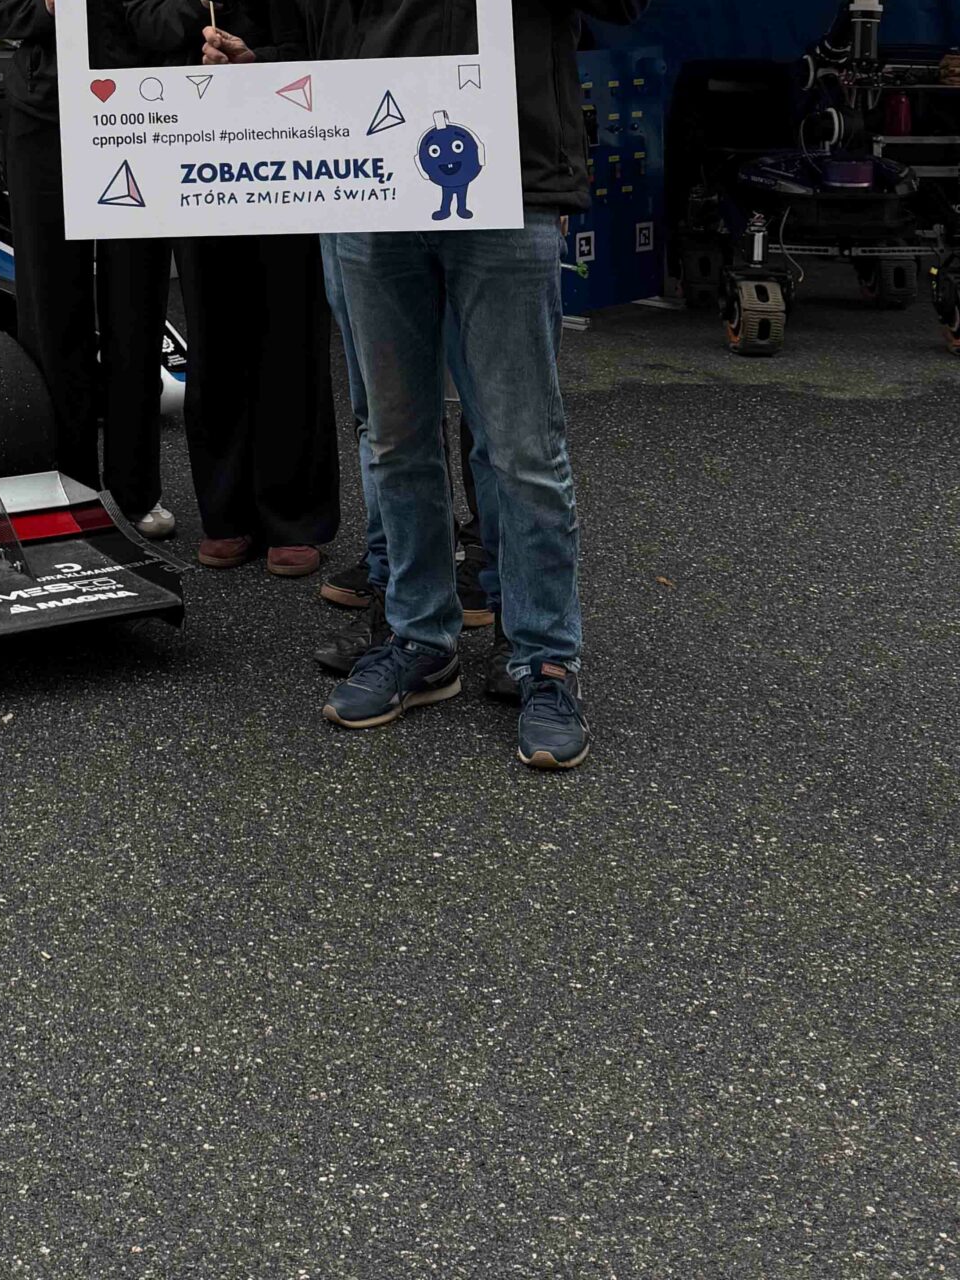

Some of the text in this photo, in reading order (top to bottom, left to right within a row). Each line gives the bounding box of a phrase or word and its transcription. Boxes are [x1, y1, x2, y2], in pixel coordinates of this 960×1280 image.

[92, 112, 179, 126] 100 000 likes
[92, 125, 350, 147] cpnpolsl #cpnpolsl #politechnikaśląska
[180, 158, 394, 185] ZOBACZ NAUKĘ,
[180, 186, 397, 207] KTÓRA ZMIENIA ŚWIAT!
[36, 590, 139, 610] MAGNA
